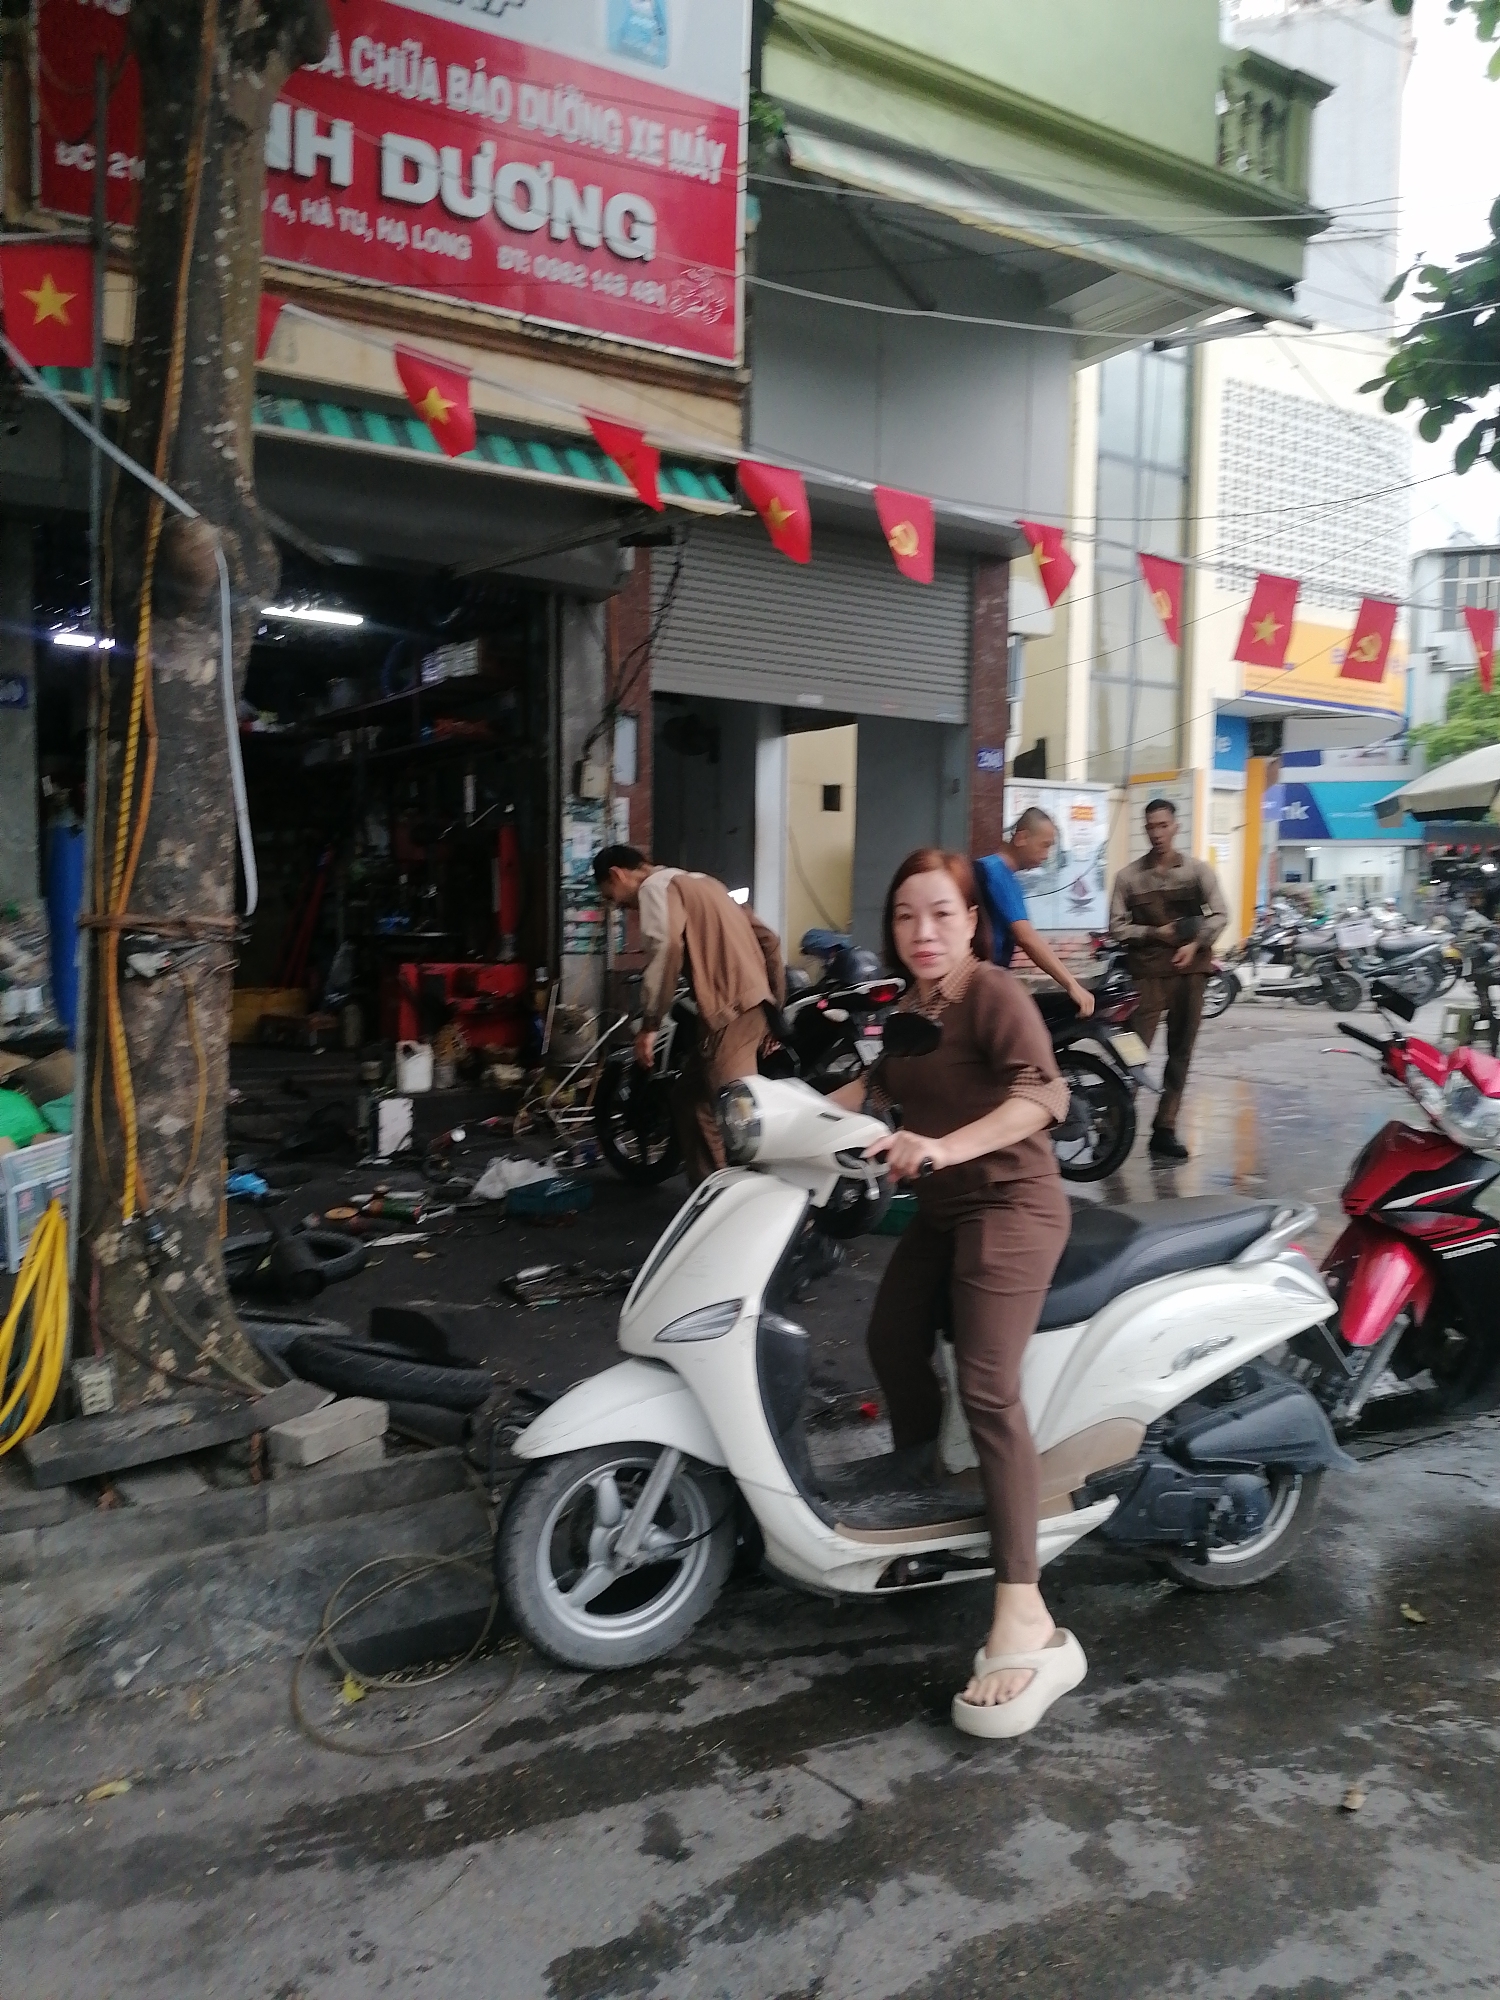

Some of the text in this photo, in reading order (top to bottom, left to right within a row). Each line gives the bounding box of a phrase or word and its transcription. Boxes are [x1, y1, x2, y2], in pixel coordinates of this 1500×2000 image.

[351, 35, 442, 105] CHỮA
[627, 115, 665, 167] XE
[381, 131, 658, 262] DƯƠNG
[411, 224, 473, 261] LONG
